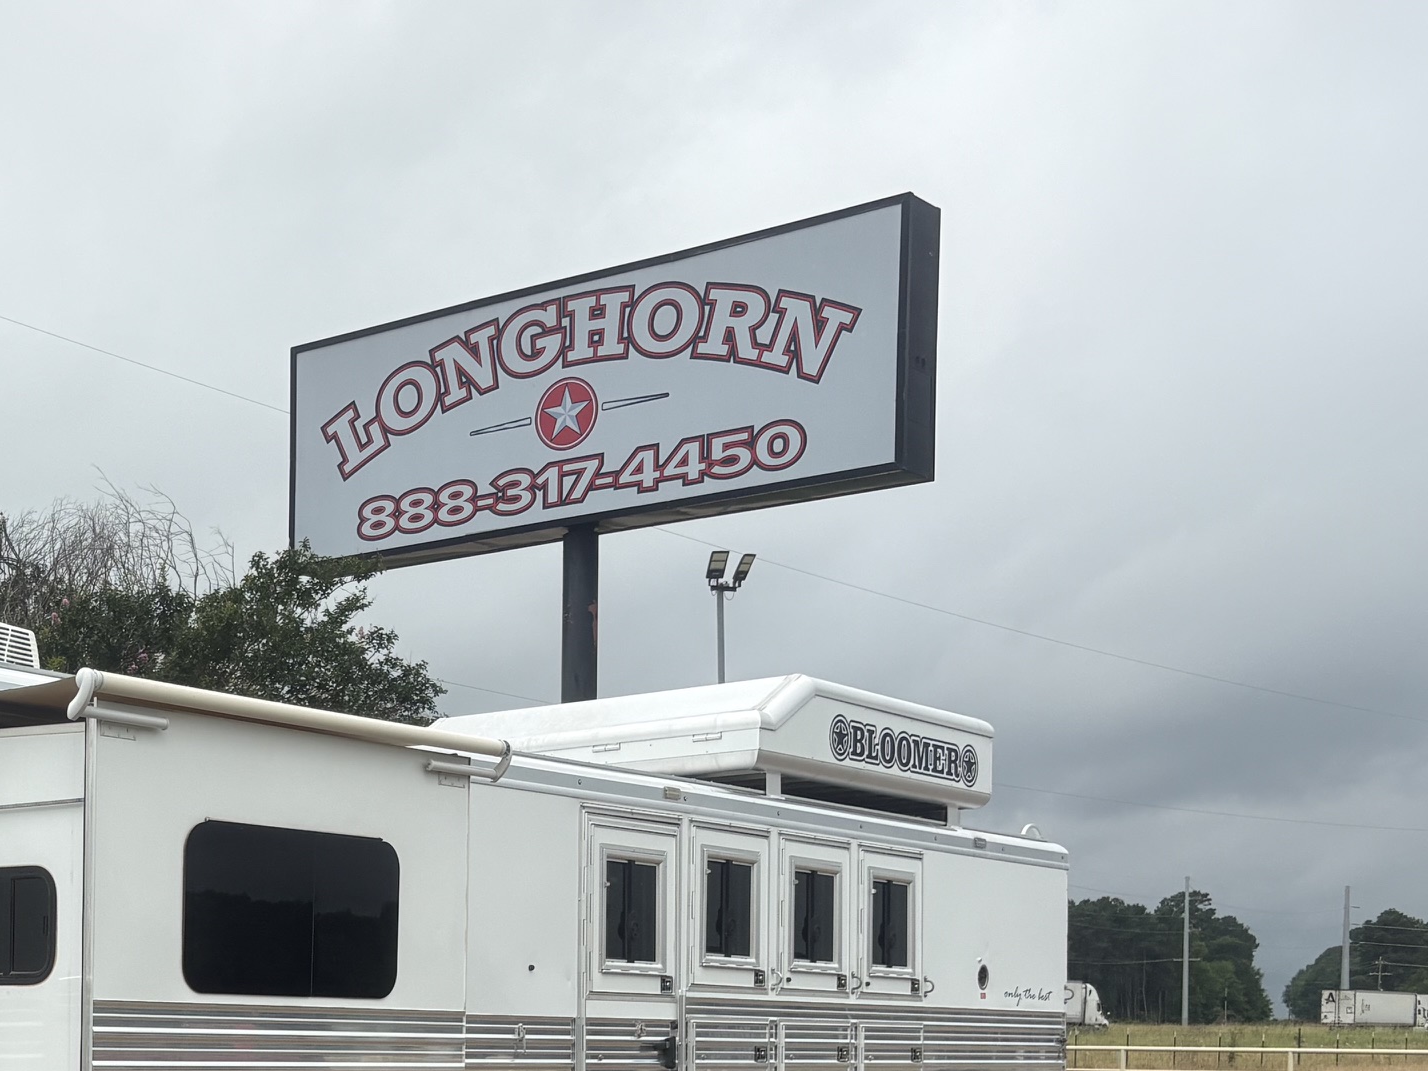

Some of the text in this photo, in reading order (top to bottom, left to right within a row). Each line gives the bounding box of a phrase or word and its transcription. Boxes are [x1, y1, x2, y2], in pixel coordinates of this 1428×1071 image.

[320, 281, 862, 481] LONGHORN
[357, 419, 807, 541] 888-317-4450
[849, 721, 962, 781] BLOOMER
[1003, 985, 1022, 1007] only
